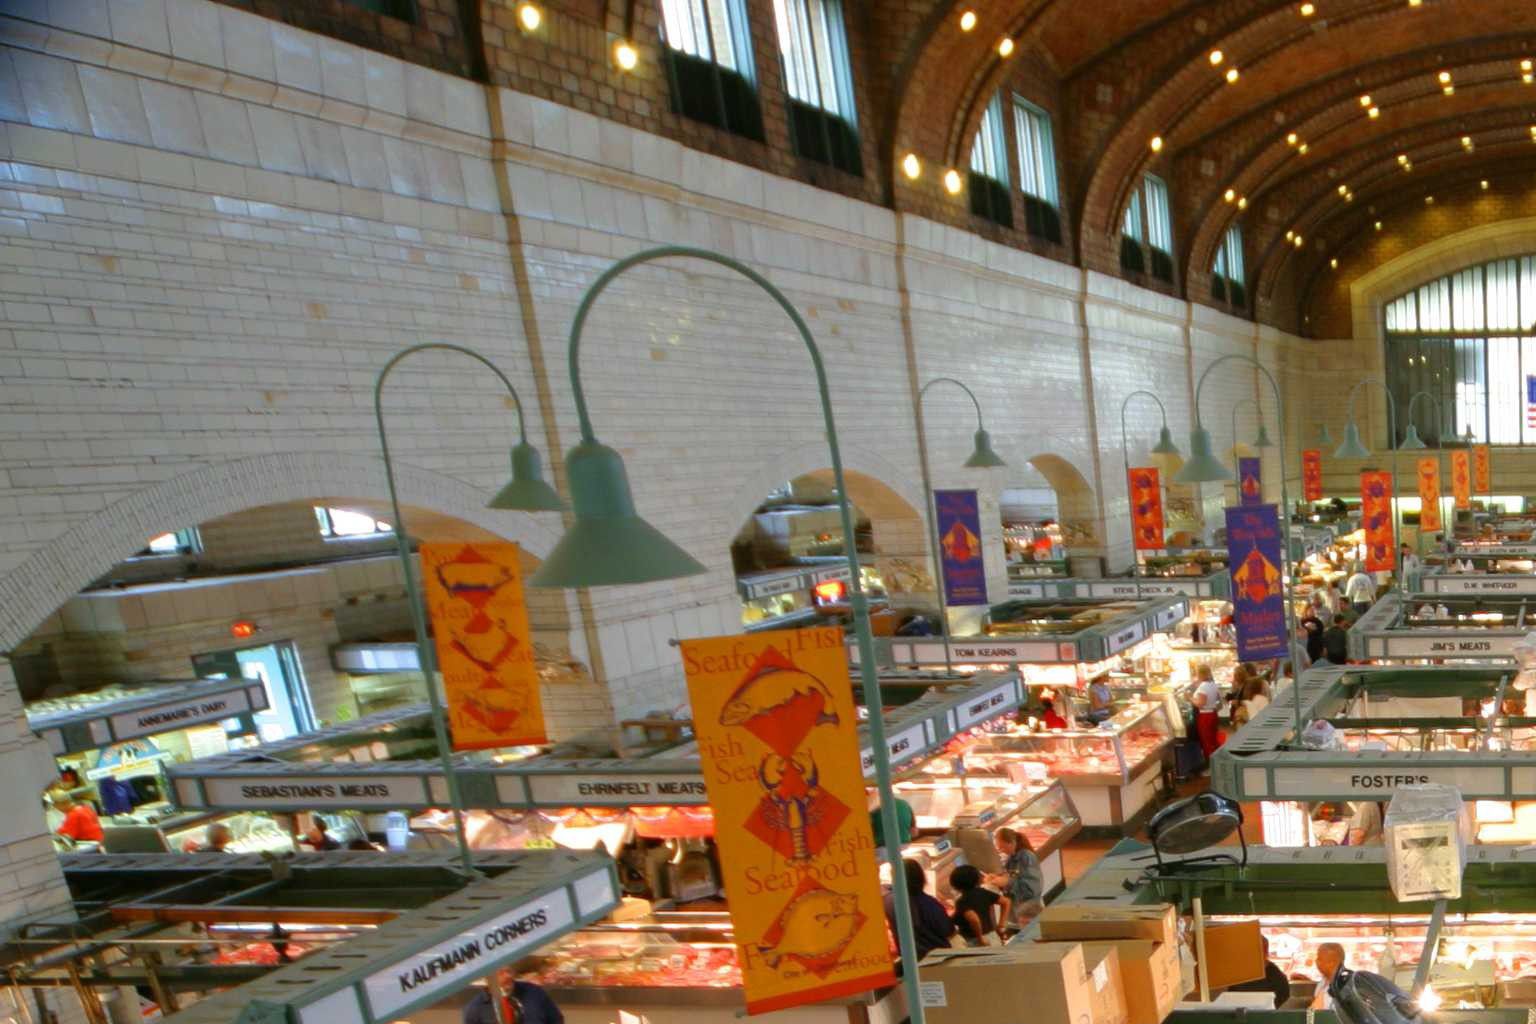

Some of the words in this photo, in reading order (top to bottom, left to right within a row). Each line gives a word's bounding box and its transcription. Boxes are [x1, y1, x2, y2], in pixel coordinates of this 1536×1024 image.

[954, 647, 976, 657] TOM
[978, 647, 1017, 657] KEARNS
[1431, 642, 1455, 651] JIM'S
[1459, 642, 1491, 651] MEATS
[685, 637, 795, 676] Seafod
[699, 733, 743, 759] ish
[1351, 775, 1429, 788] FOSTER'S
[241, 784, 334, 798] SEBASTIAN'S
[340, 784, 389, 798] MEATS
[577, 782, 652, 796] EHRNFELT
[656, 782, 707, 796] MEATS
[397, 940, 481, 992] KAUFMANN
[484, 908, 548, 951] CORNERS
